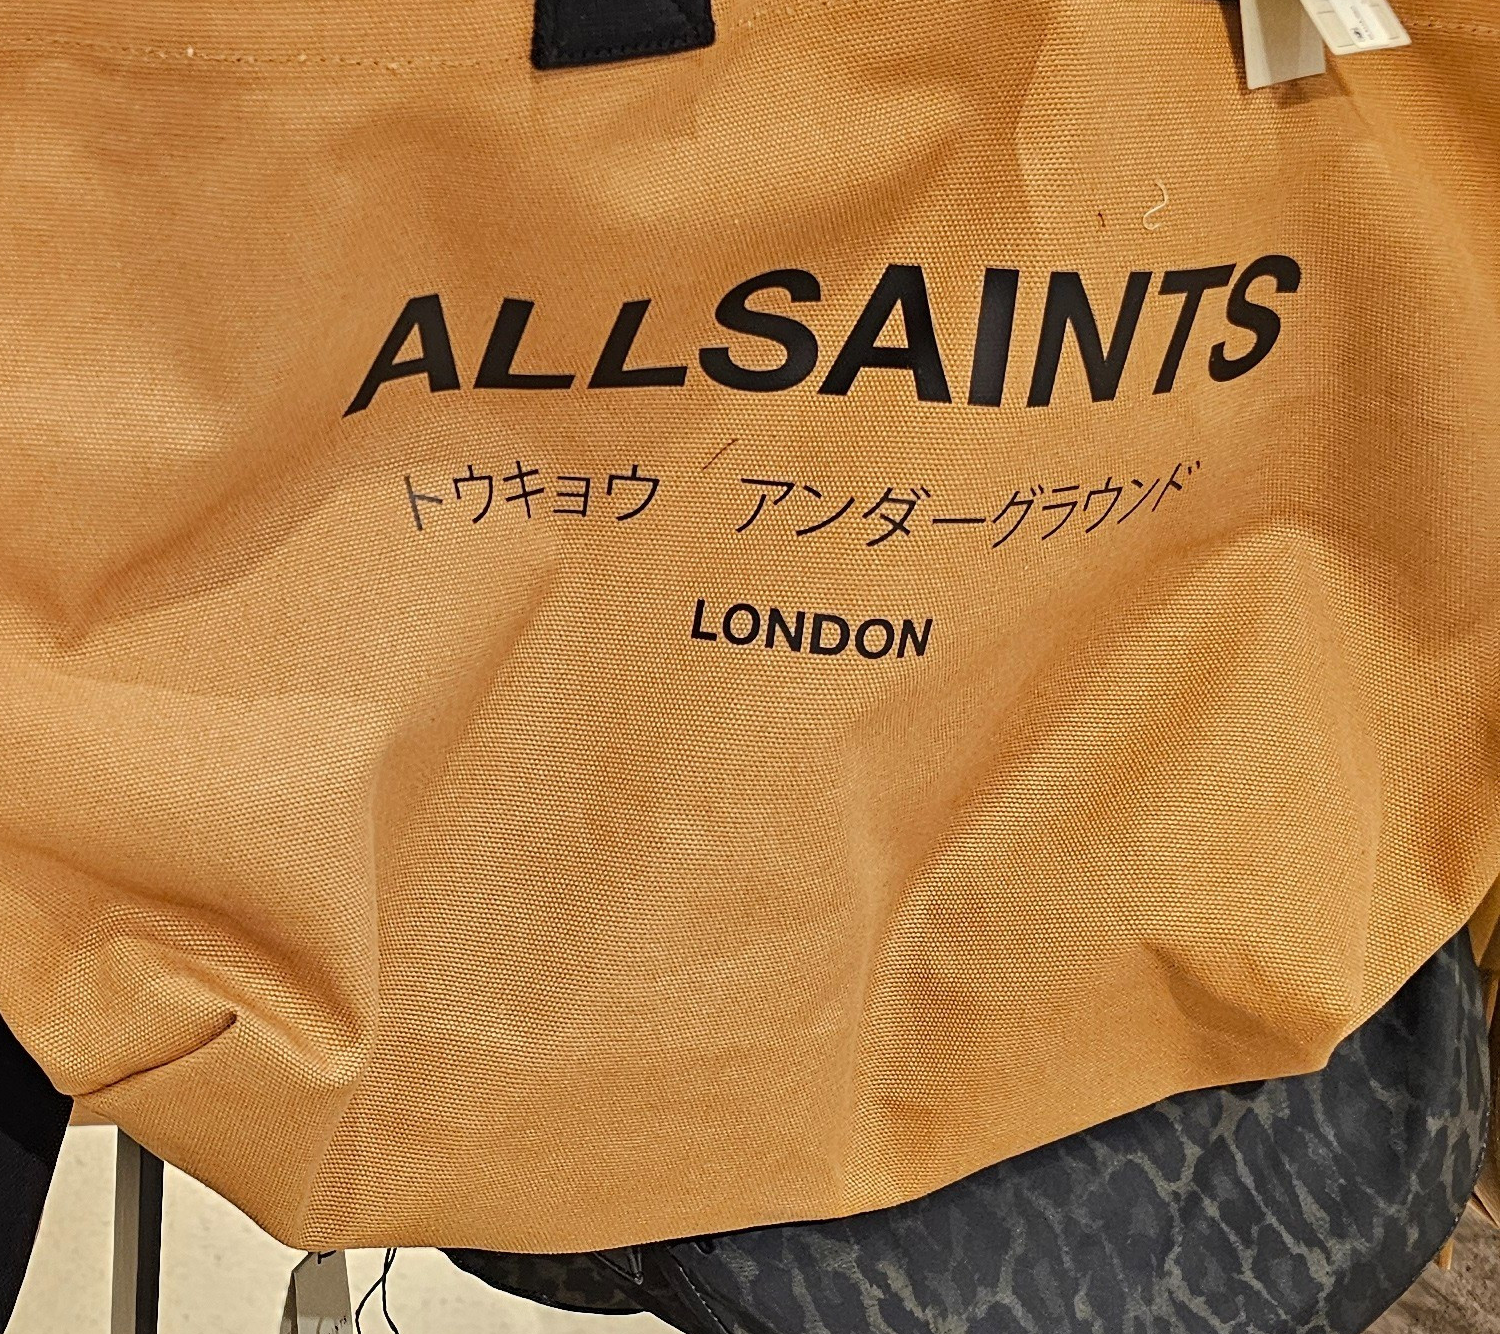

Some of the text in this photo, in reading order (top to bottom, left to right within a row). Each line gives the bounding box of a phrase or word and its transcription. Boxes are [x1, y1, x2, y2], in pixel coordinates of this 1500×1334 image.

[342, 255, 1302, 418] ALLSAINTS
[404, 460, 1203, 550] トウキョウ アンダーグラウンド
[690, 598, 934, 660] LONDON
